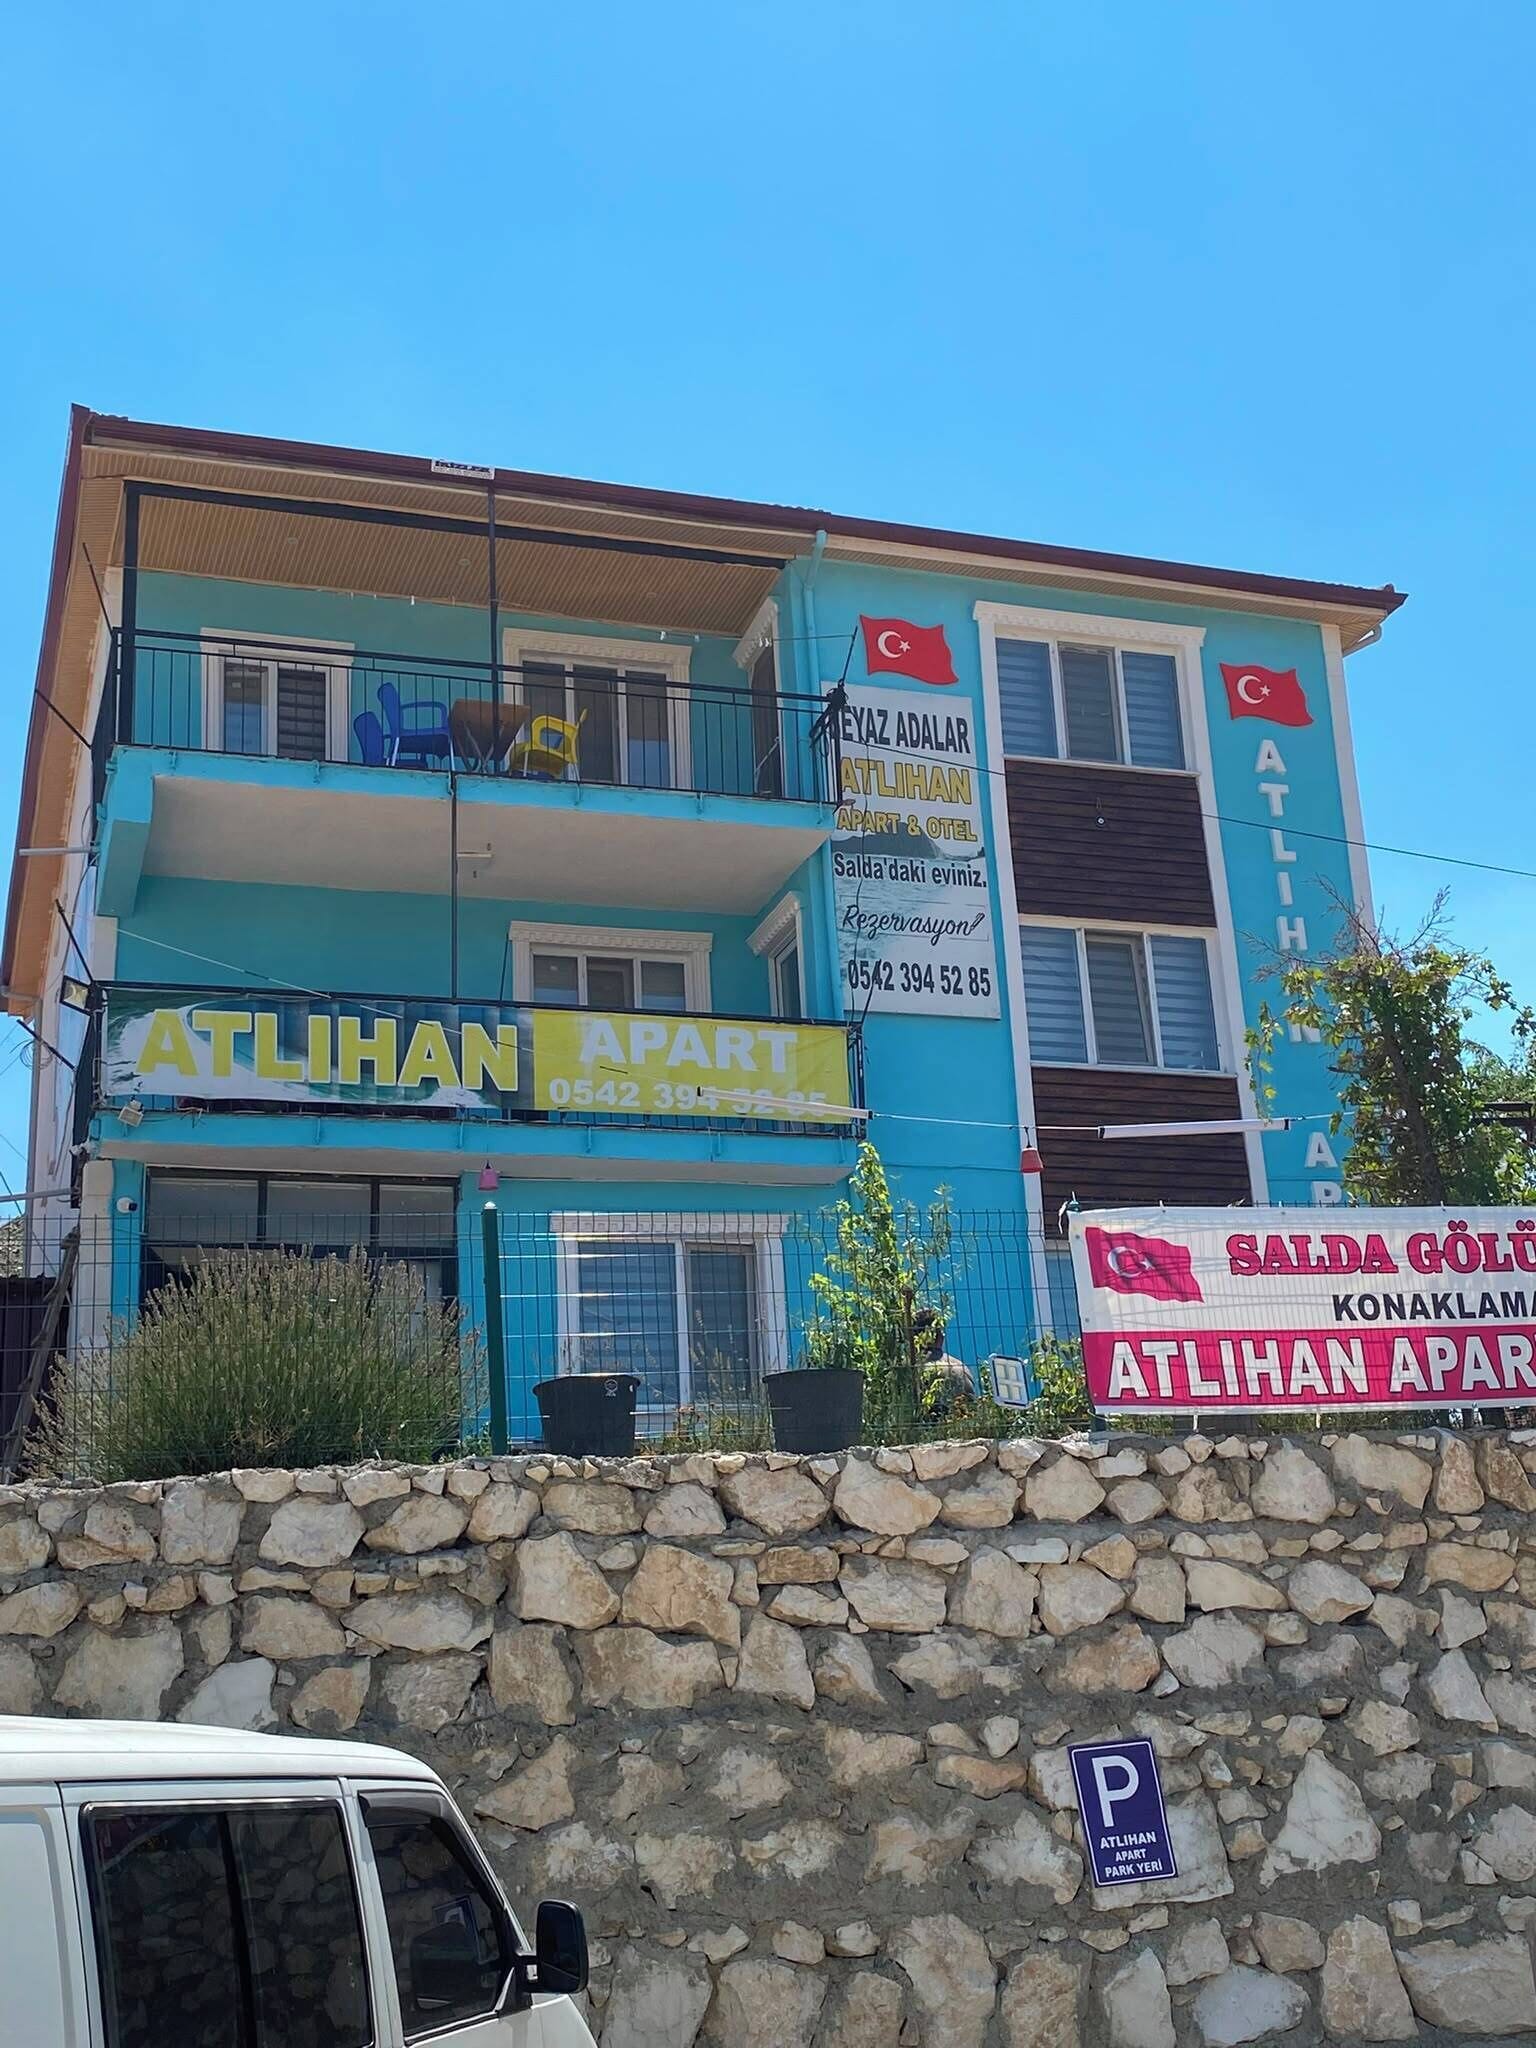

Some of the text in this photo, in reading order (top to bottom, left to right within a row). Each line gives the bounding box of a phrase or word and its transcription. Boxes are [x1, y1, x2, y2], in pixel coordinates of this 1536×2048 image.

[839, 705, 971, 753] EYAZ ADALAR
[840, 757, 972, 805] ATLIHAN
[836, 808, 977, 841] APART & OTEL
[834, 852, 987, 888] Salda'daki eviniz.
[848, 959, 991, 997] 0542 394 52 85
[136, 1008, 798, 1092] ATLIHAN APART
[549, 1078, 641, 1107] 0542
[653, 1082, 720, 1112] 394
[1225, 1233, 1398, 1275] SALDA
[1332, 1290, 1536, 1321] KONAKLAM
[1107, 1333, 1536, 1399] ATLIHAN APAR
[1091, 1755, 1139, 1828] P
[1100, 1831, 1157, 1849] ATLIHAN
[1115, 1848, 1147, 1862] APART
[1105, 1858, 1163, 1877] PARK YERİ
